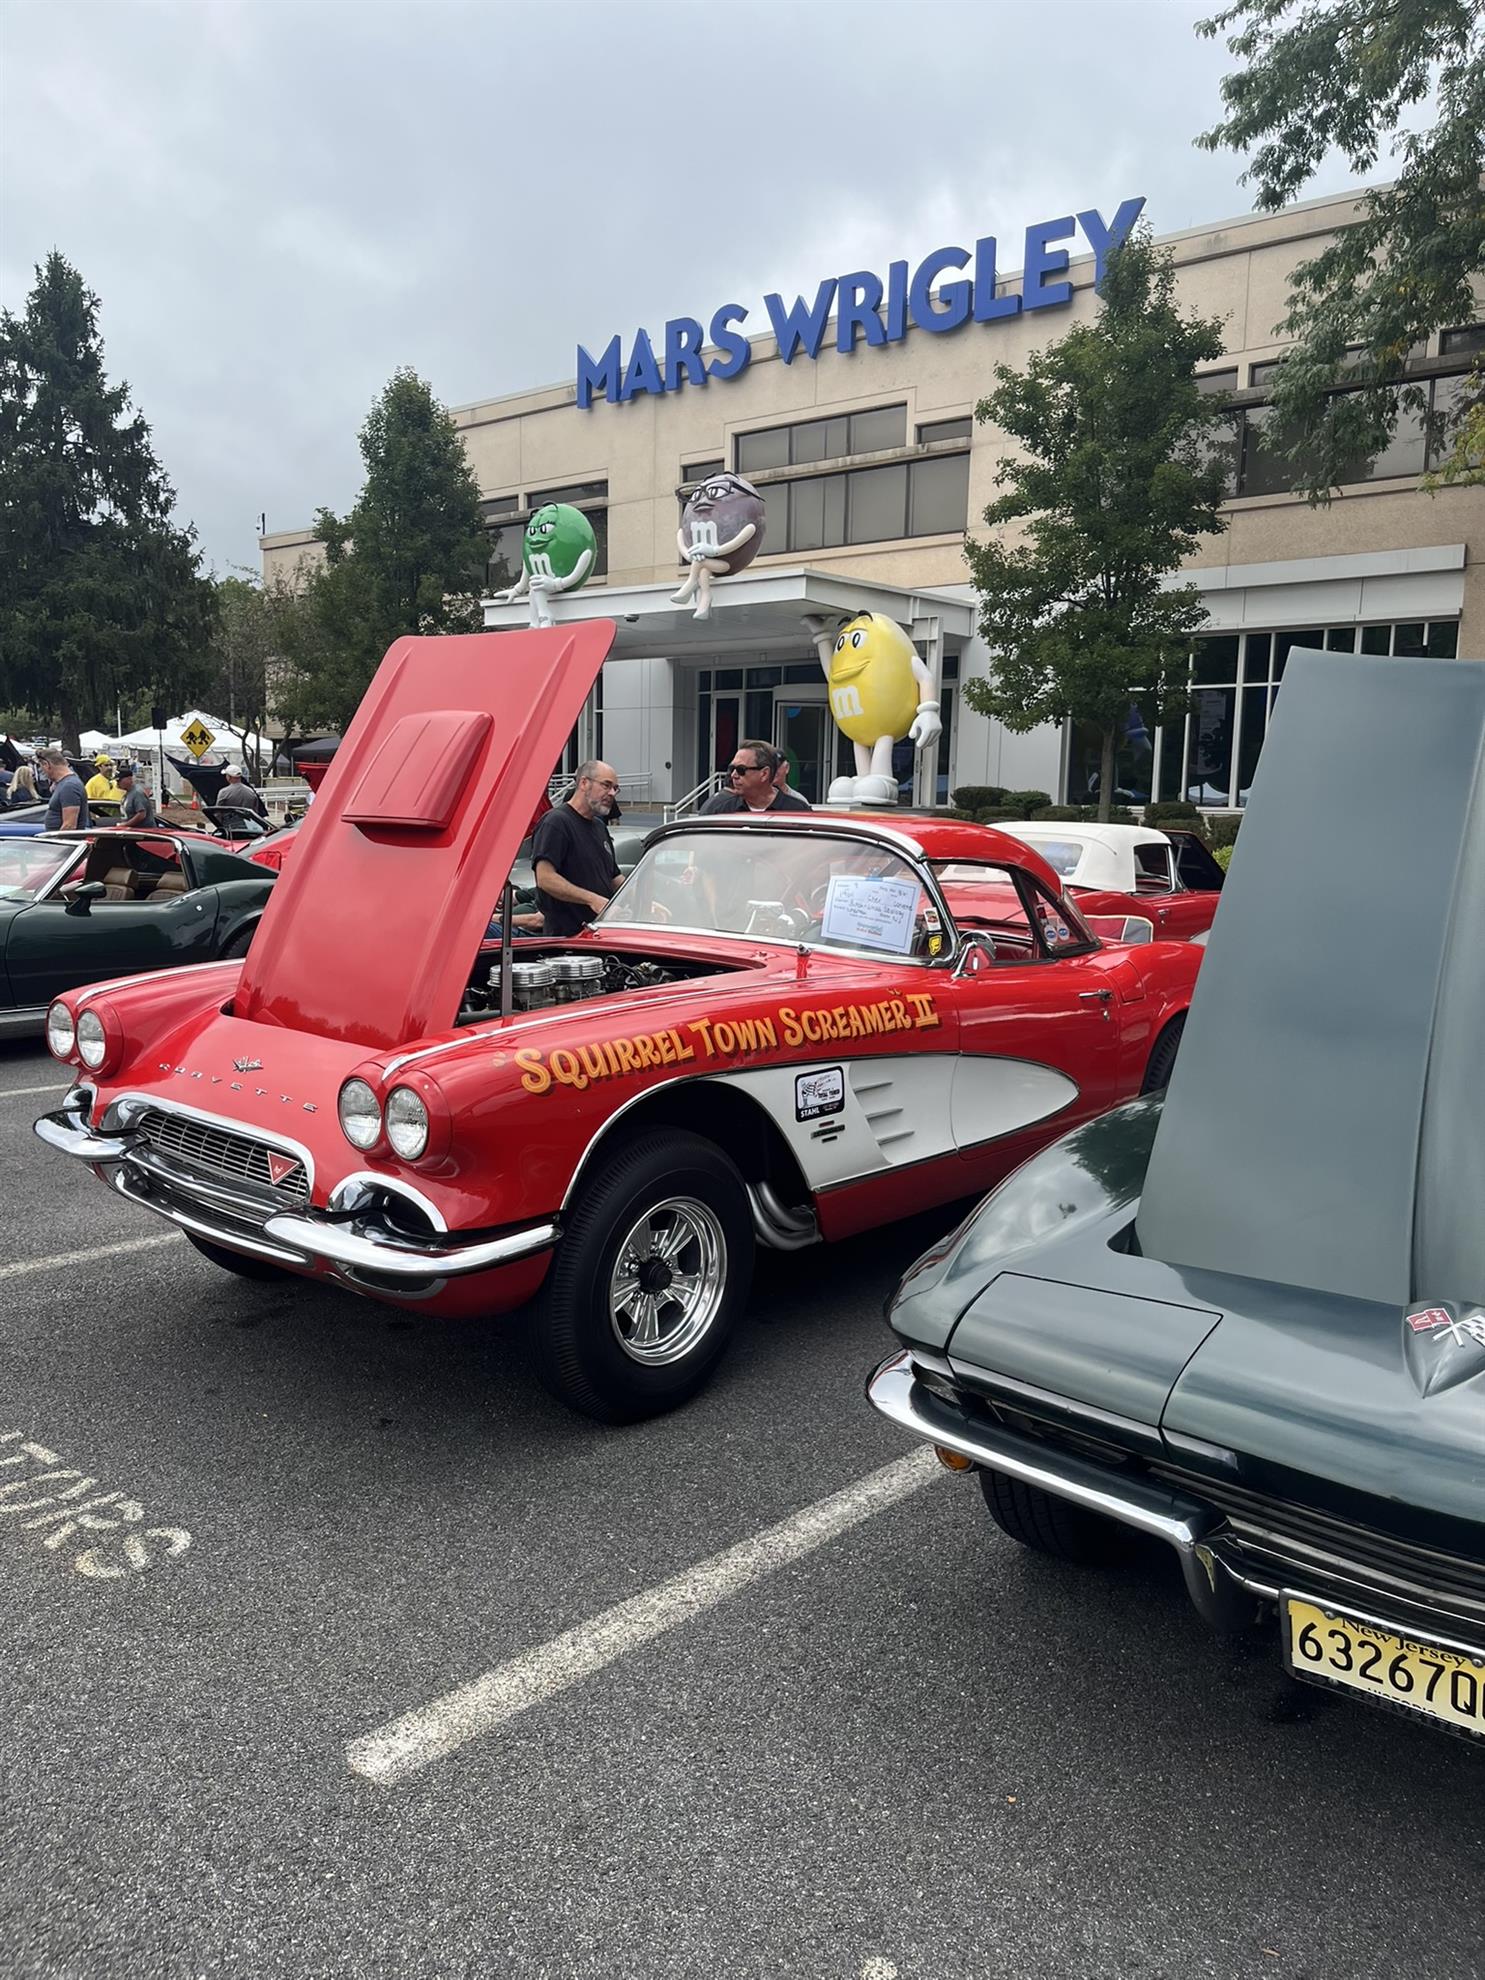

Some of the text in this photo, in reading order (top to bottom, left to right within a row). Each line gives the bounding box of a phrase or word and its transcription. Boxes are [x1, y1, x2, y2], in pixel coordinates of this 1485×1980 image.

[576, 196, 1147, 410] MARS WRIGLEY
[832, 685, 864, 720] m
[513, 993, 940, 1094] SQUIRREL TOWN SCREAMER II
[800, 1106, 820, 1119] STAHL
[1298, 1621, 1485, 1719] 63267Q
[1341, 1618, 1467, 1669] New Jersey
